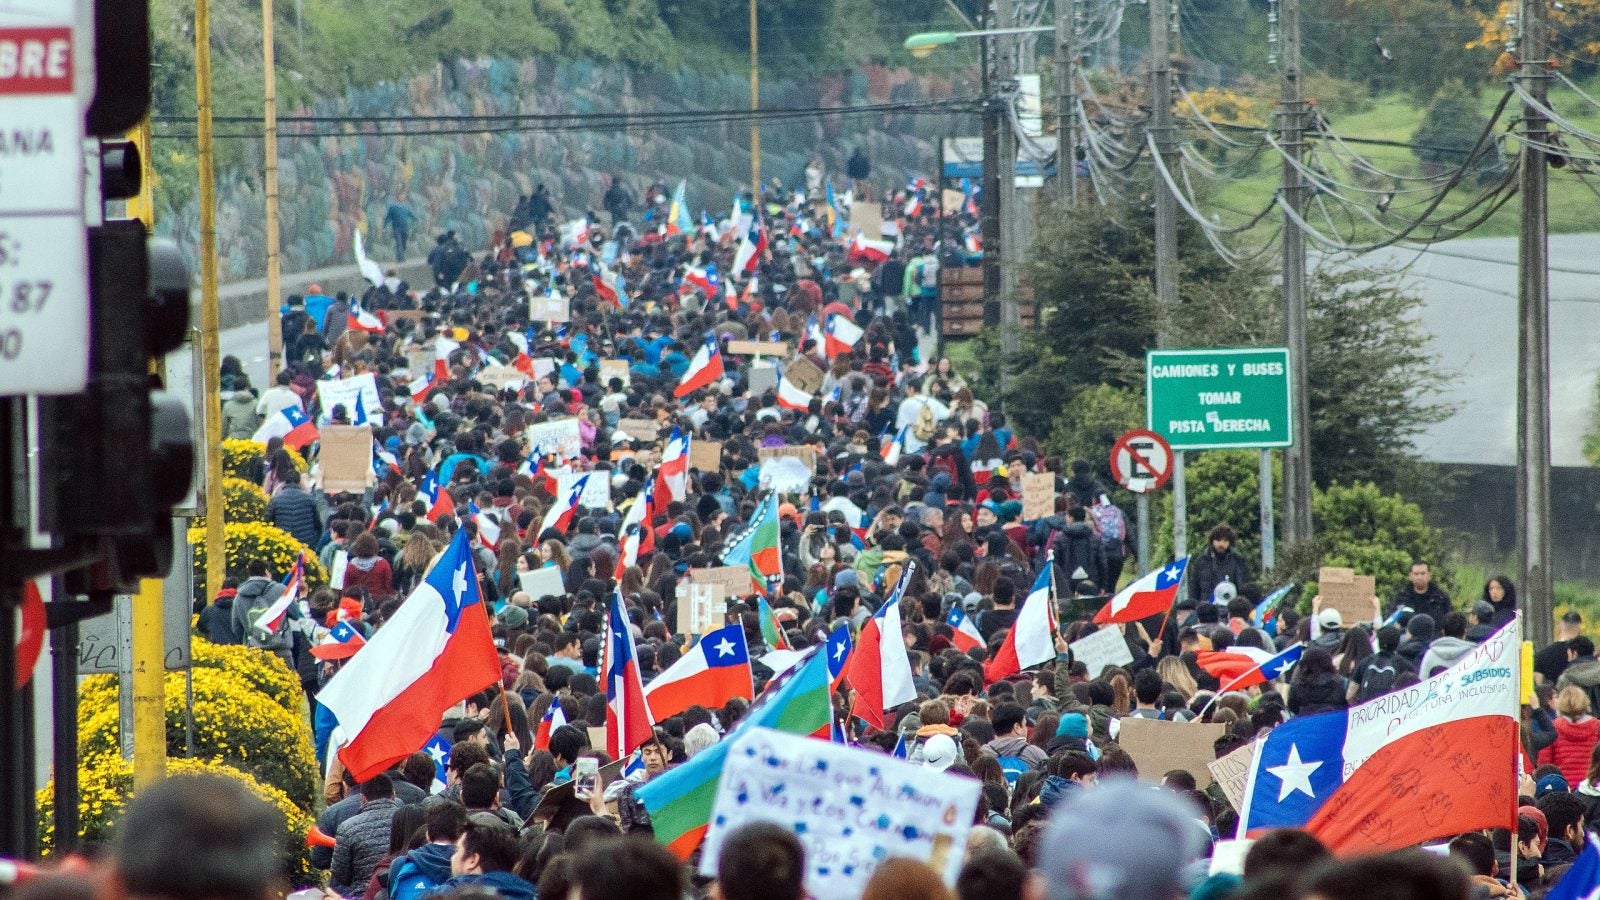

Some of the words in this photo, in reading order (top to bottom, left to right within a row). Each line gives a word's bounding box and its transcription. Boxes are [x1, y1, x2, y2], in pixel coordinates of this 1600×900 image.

[0, 326, 23, 361] 0
[1152, 364, 1219, 378] CAMIONES
[1227, 364, 1236, 376] Y
[1243, 362, 1284, 376] BUSES
[1198, 391, 1242, 405] TOMAR
[1169, 420, 1205, 433] PISTA
[1213, 418, 1271, 433] DERECHA
[1129, 442, 1154, 479] E
[1461, 667, 1511, 688] SUBSIDIOS
[1459, 683, 1508, 701] INCLUSIVA
[1351, 688, 1420, 730] PRIORIDAD
